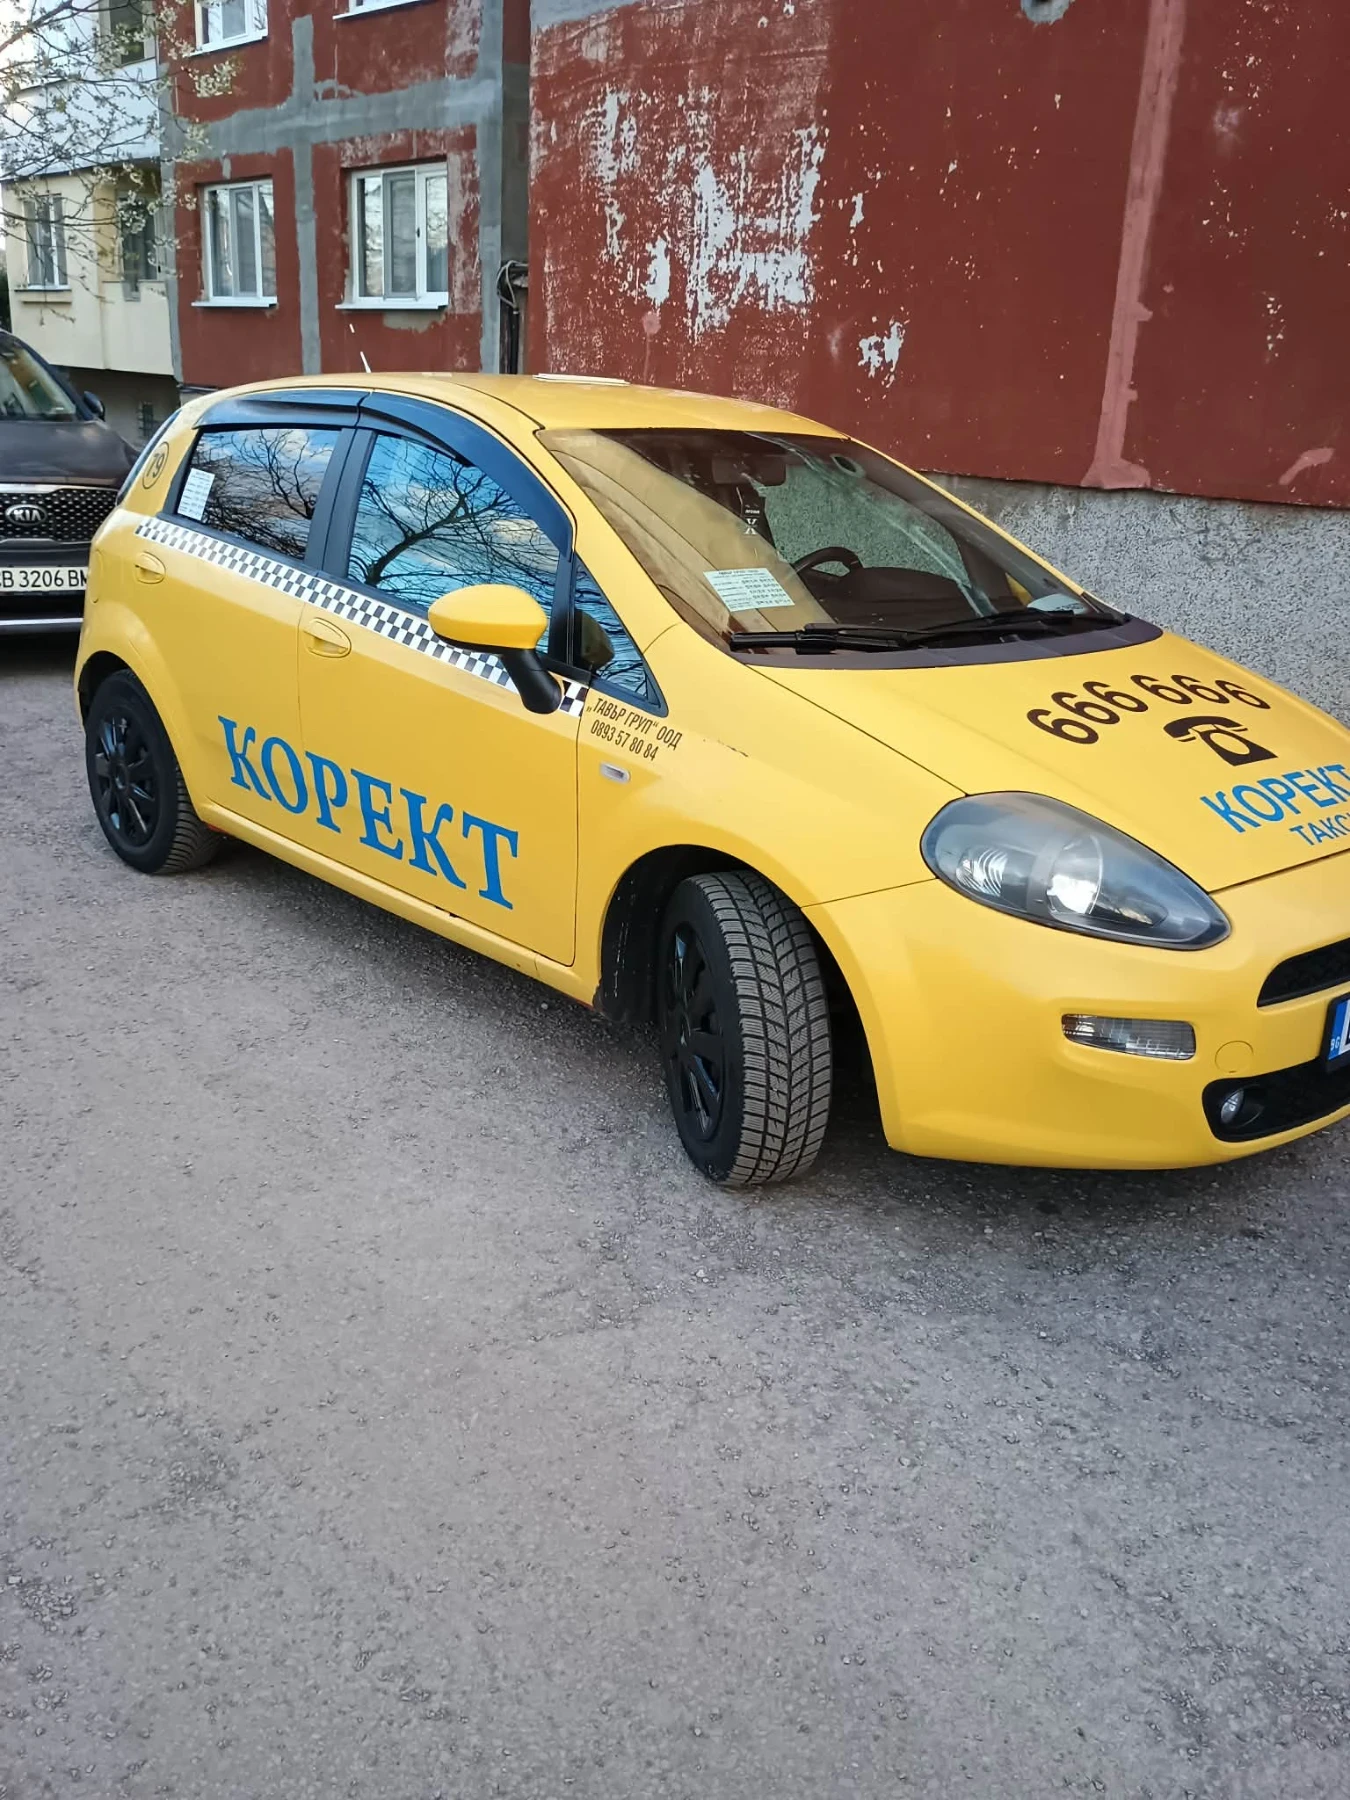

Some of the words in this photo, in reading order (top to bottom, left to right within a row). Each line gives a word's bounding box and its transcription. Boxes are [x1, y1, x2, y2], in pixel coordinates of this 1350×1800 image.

[13, 509, 42, 522] KIA
[19, 570, 64, 588] 3206
[590, 720, 616, 742] 0893
[615, 730, 631, 747] 57
[629, 736, 644, 754] 80
[643, 746, 659, 761] 84
[656, 726, 682, 750] ООД
[218, 715, 518, 910] КОРЕКТ
[1289, 813, 1350, 846] ТАКС
